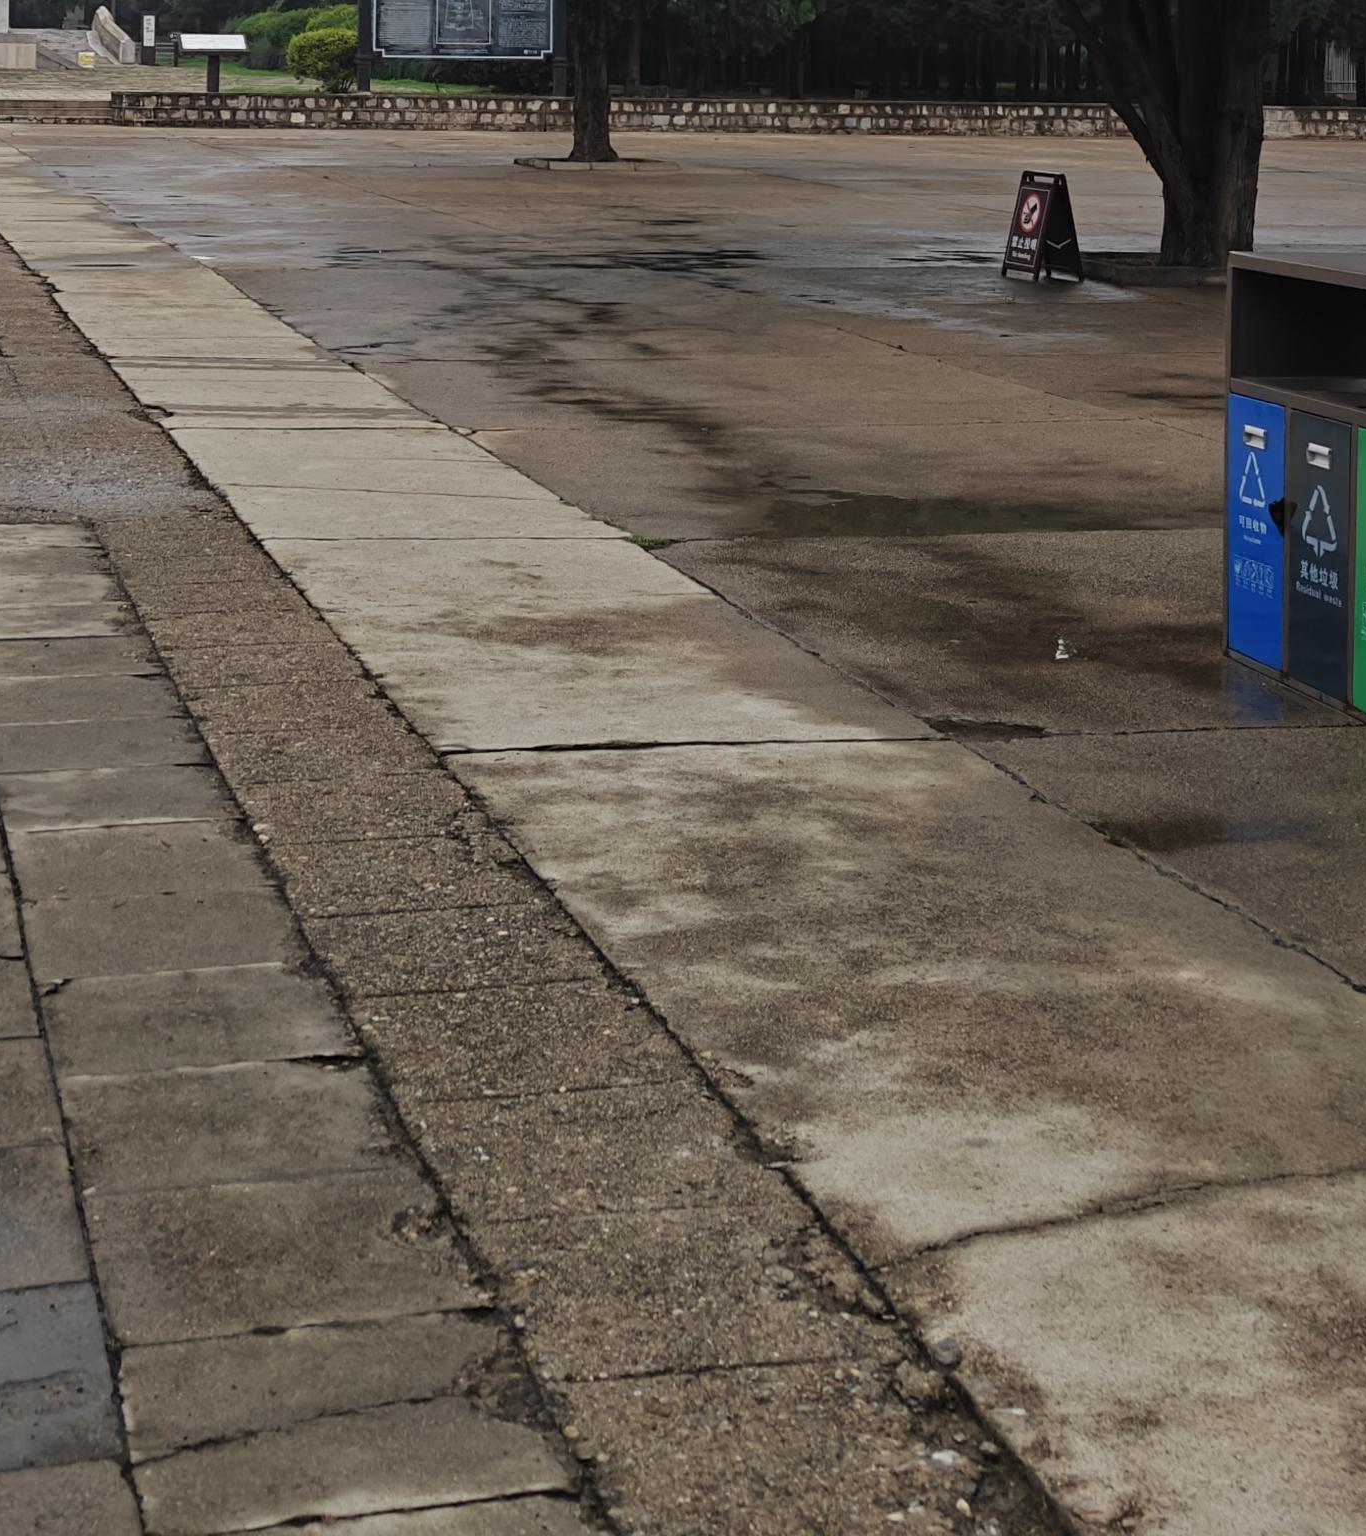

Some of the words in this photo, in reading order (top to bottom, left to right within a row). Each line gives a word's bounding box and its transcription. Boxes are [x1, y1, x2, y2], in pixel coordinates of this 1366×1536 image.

[1238, 515, 1267, 535] 可回收物
[1300, 559, 1339, 590] 其他垃圾
[1295, 581, 1321, 600] Residual
